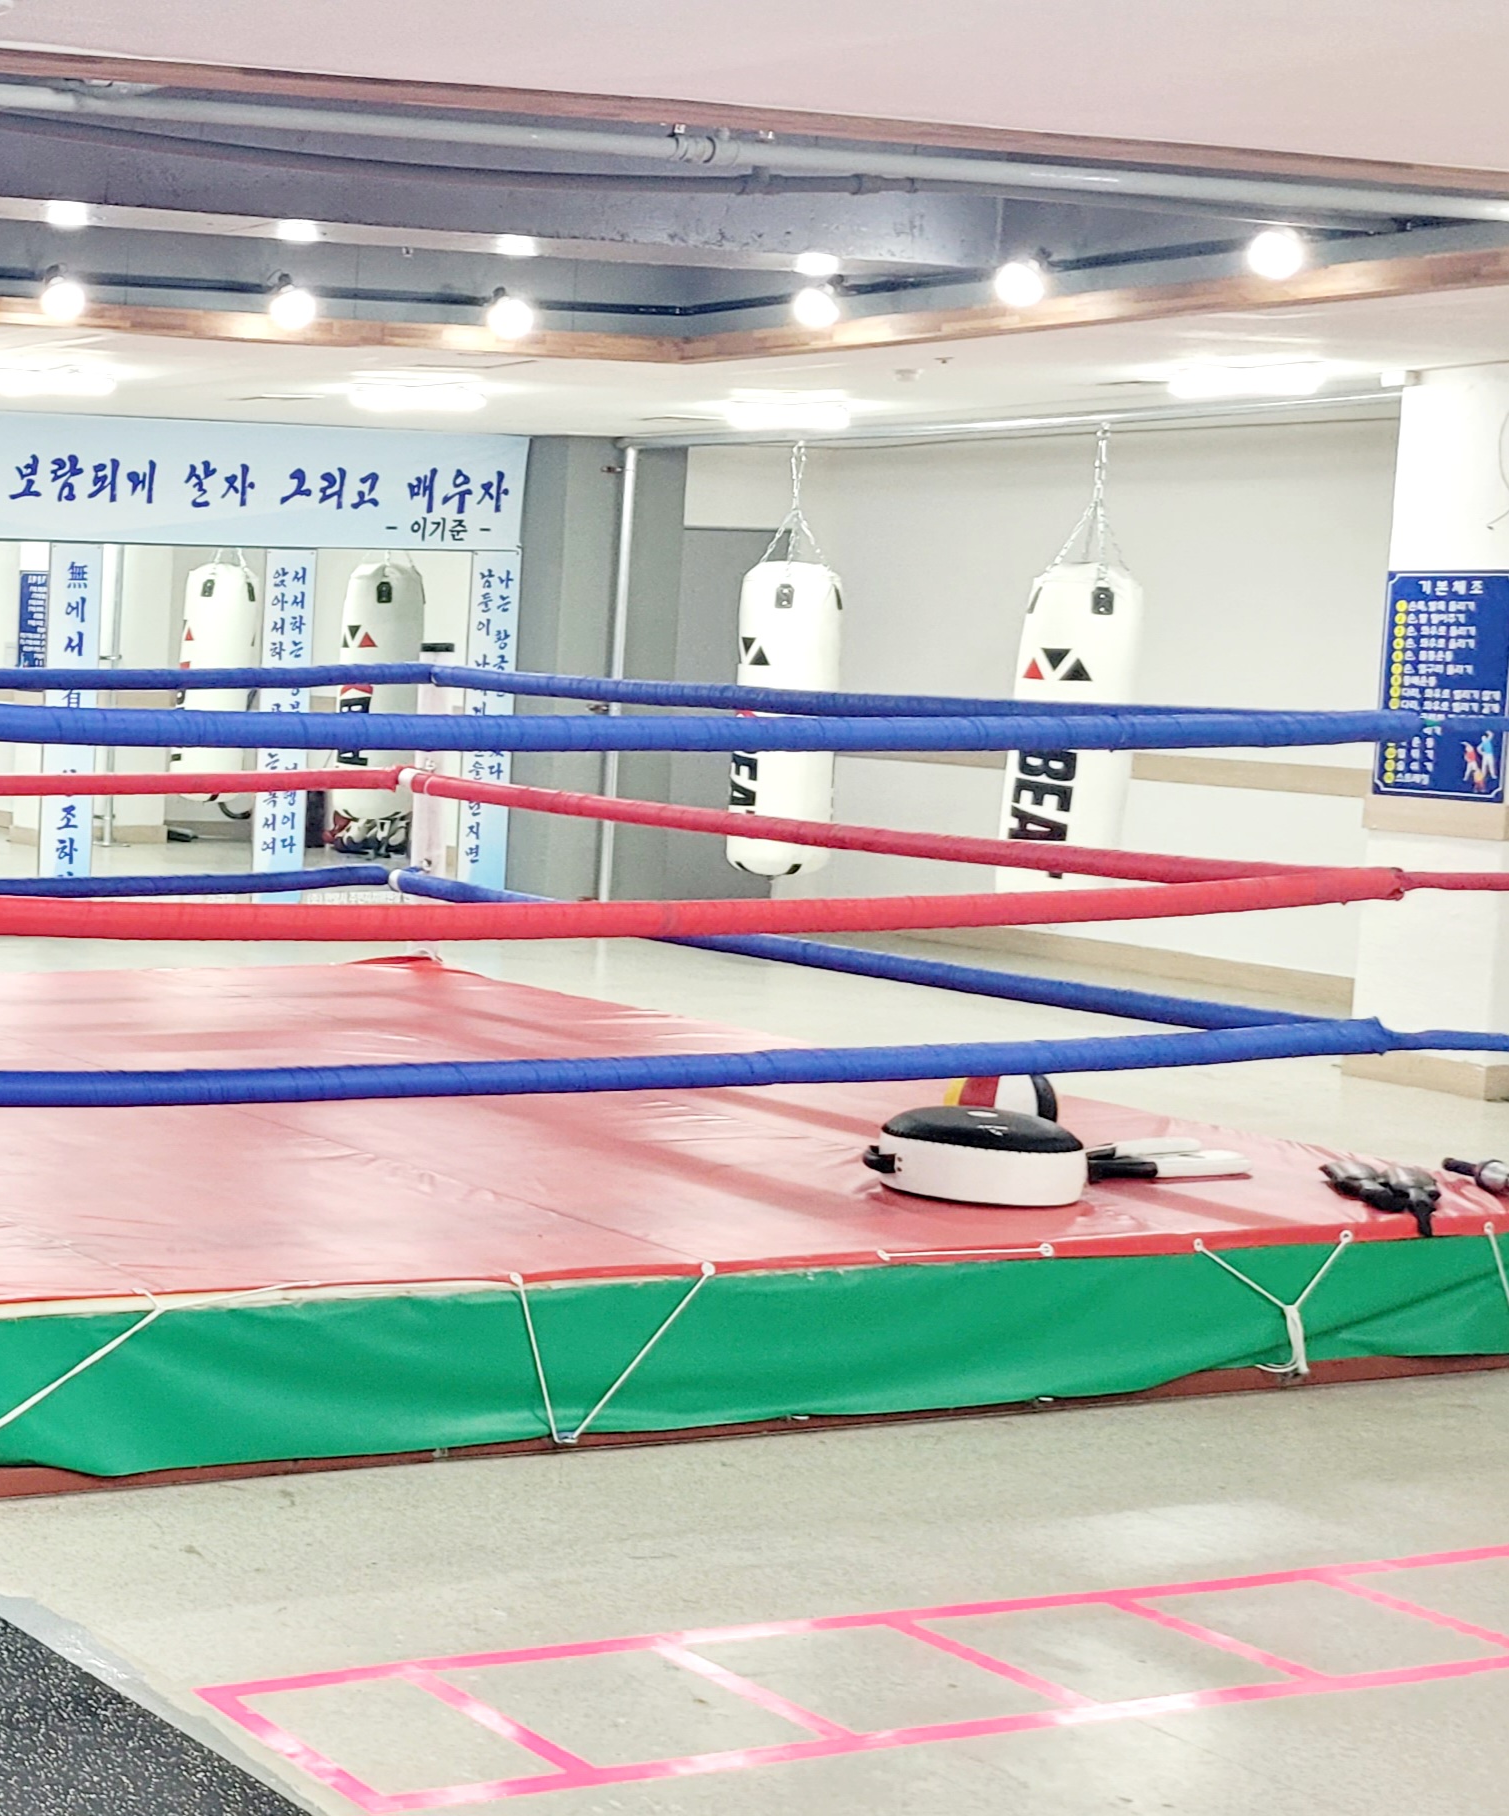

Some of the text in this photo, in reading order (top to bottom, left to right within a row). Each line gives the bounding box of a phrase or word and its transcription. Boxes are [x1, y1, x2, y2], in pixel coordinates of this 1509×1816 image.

[9, 454, 156, 503] 보람되게
[186, 461, 254, 508] 살자
[280, 467, 380, 510] 그리고
[408, 469, 509, 514] 배우자
[410, 518, 468, 541] 이기준
